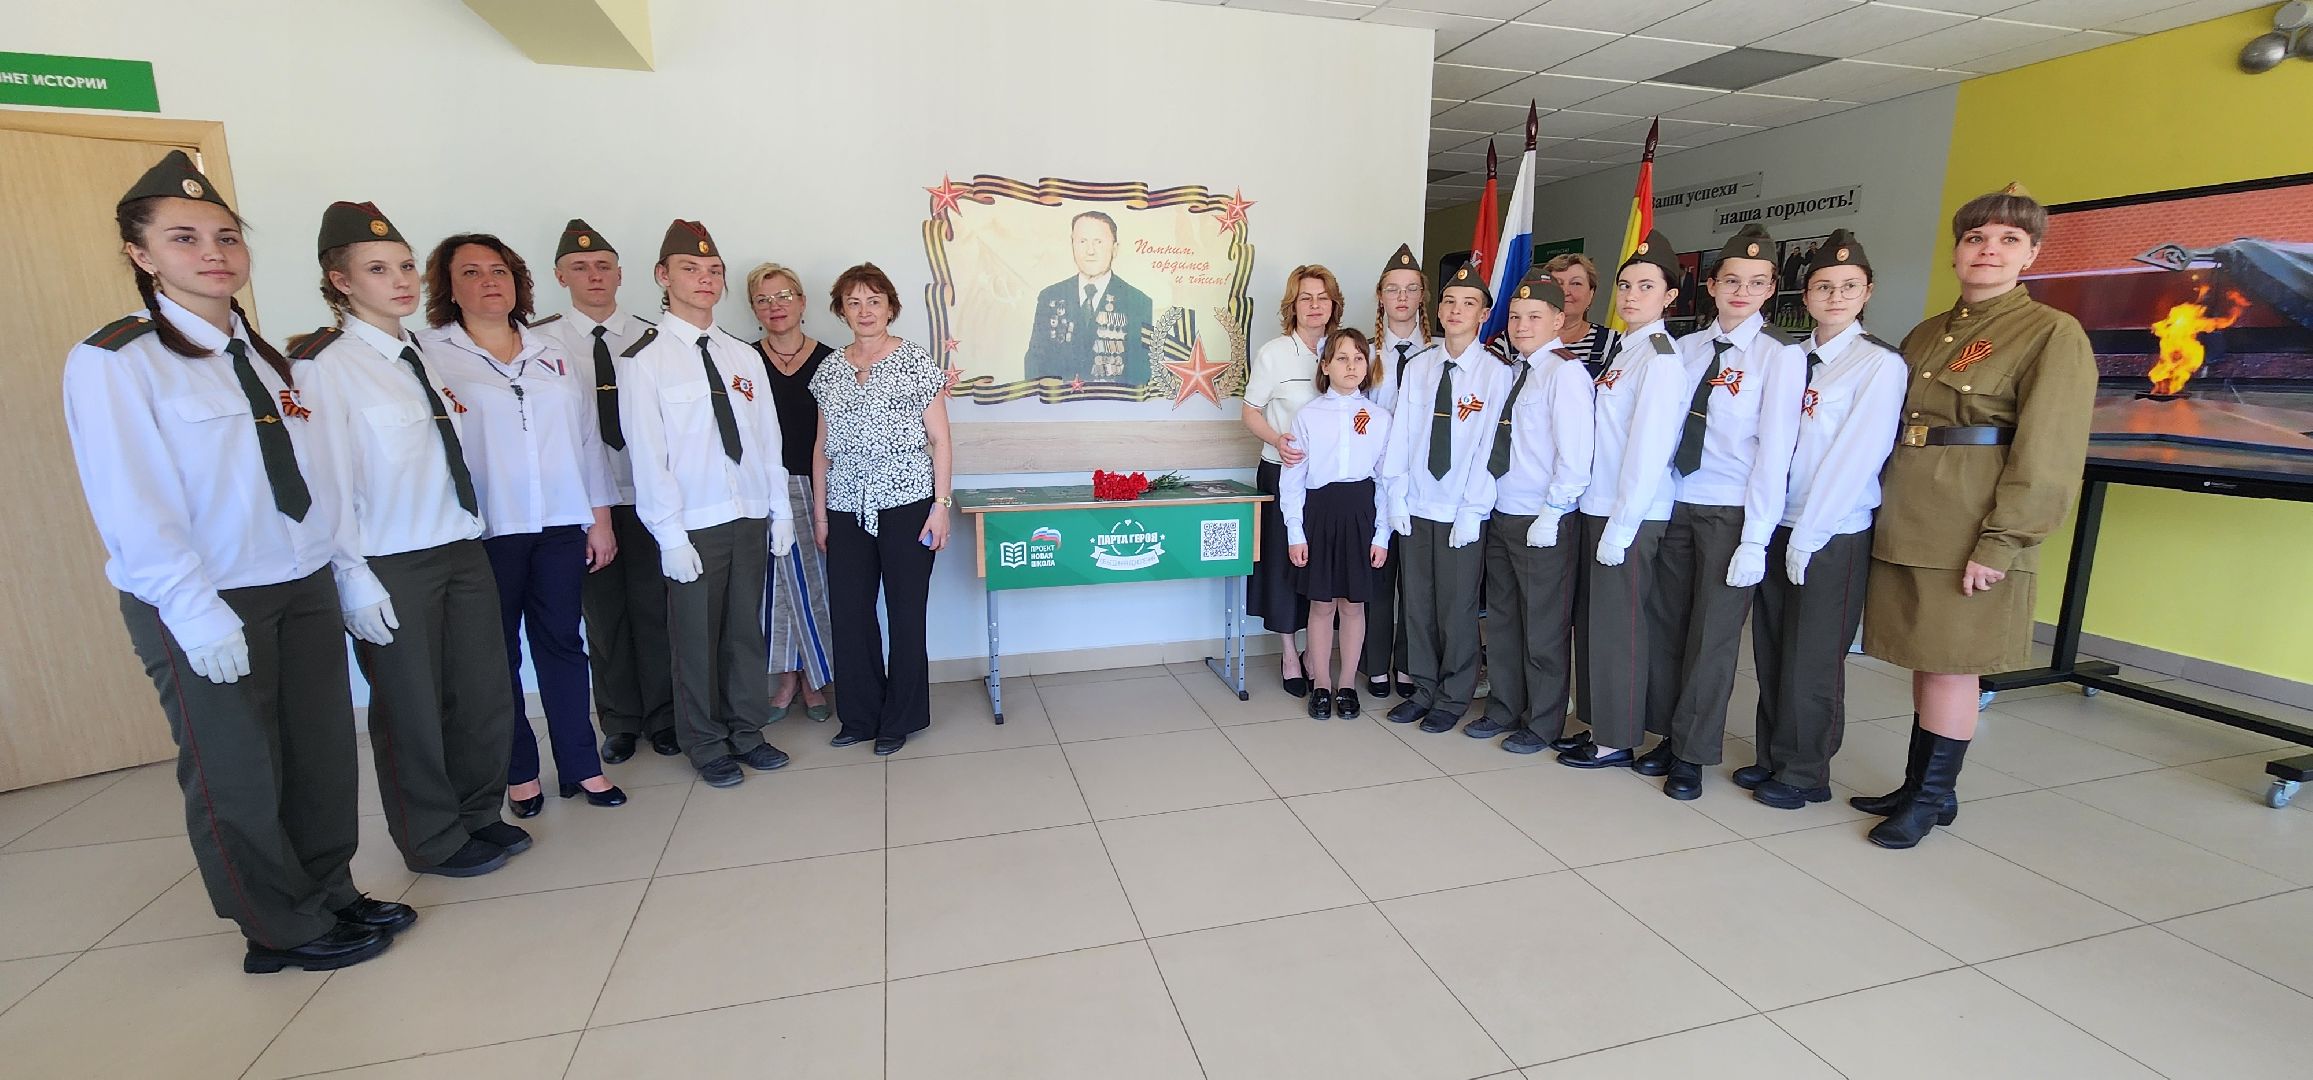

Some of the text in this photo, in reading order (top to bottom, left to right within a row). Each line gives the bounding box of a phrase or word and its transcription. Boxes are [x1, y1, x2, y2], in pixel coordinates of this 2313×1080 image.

[0, 72, 107, 89] НЕТ ИСТОРИИ
[1686, 183, 1738, 207] успехи
[1719, 190, 1854, 225] наша гордость!
[1152, 259, 1210, 274] гордимся
[1175, 273, 1231, 285] и чтим!
[1097, 532, 1158, 546] ПАРТА ГЕРОЯ
[1030, 545, 1056, 553] ПРОЕКТ
[1030, 552, 1053, 560] НОВАЯ
[1030, 560, 1056, 568] ШКОЛА
